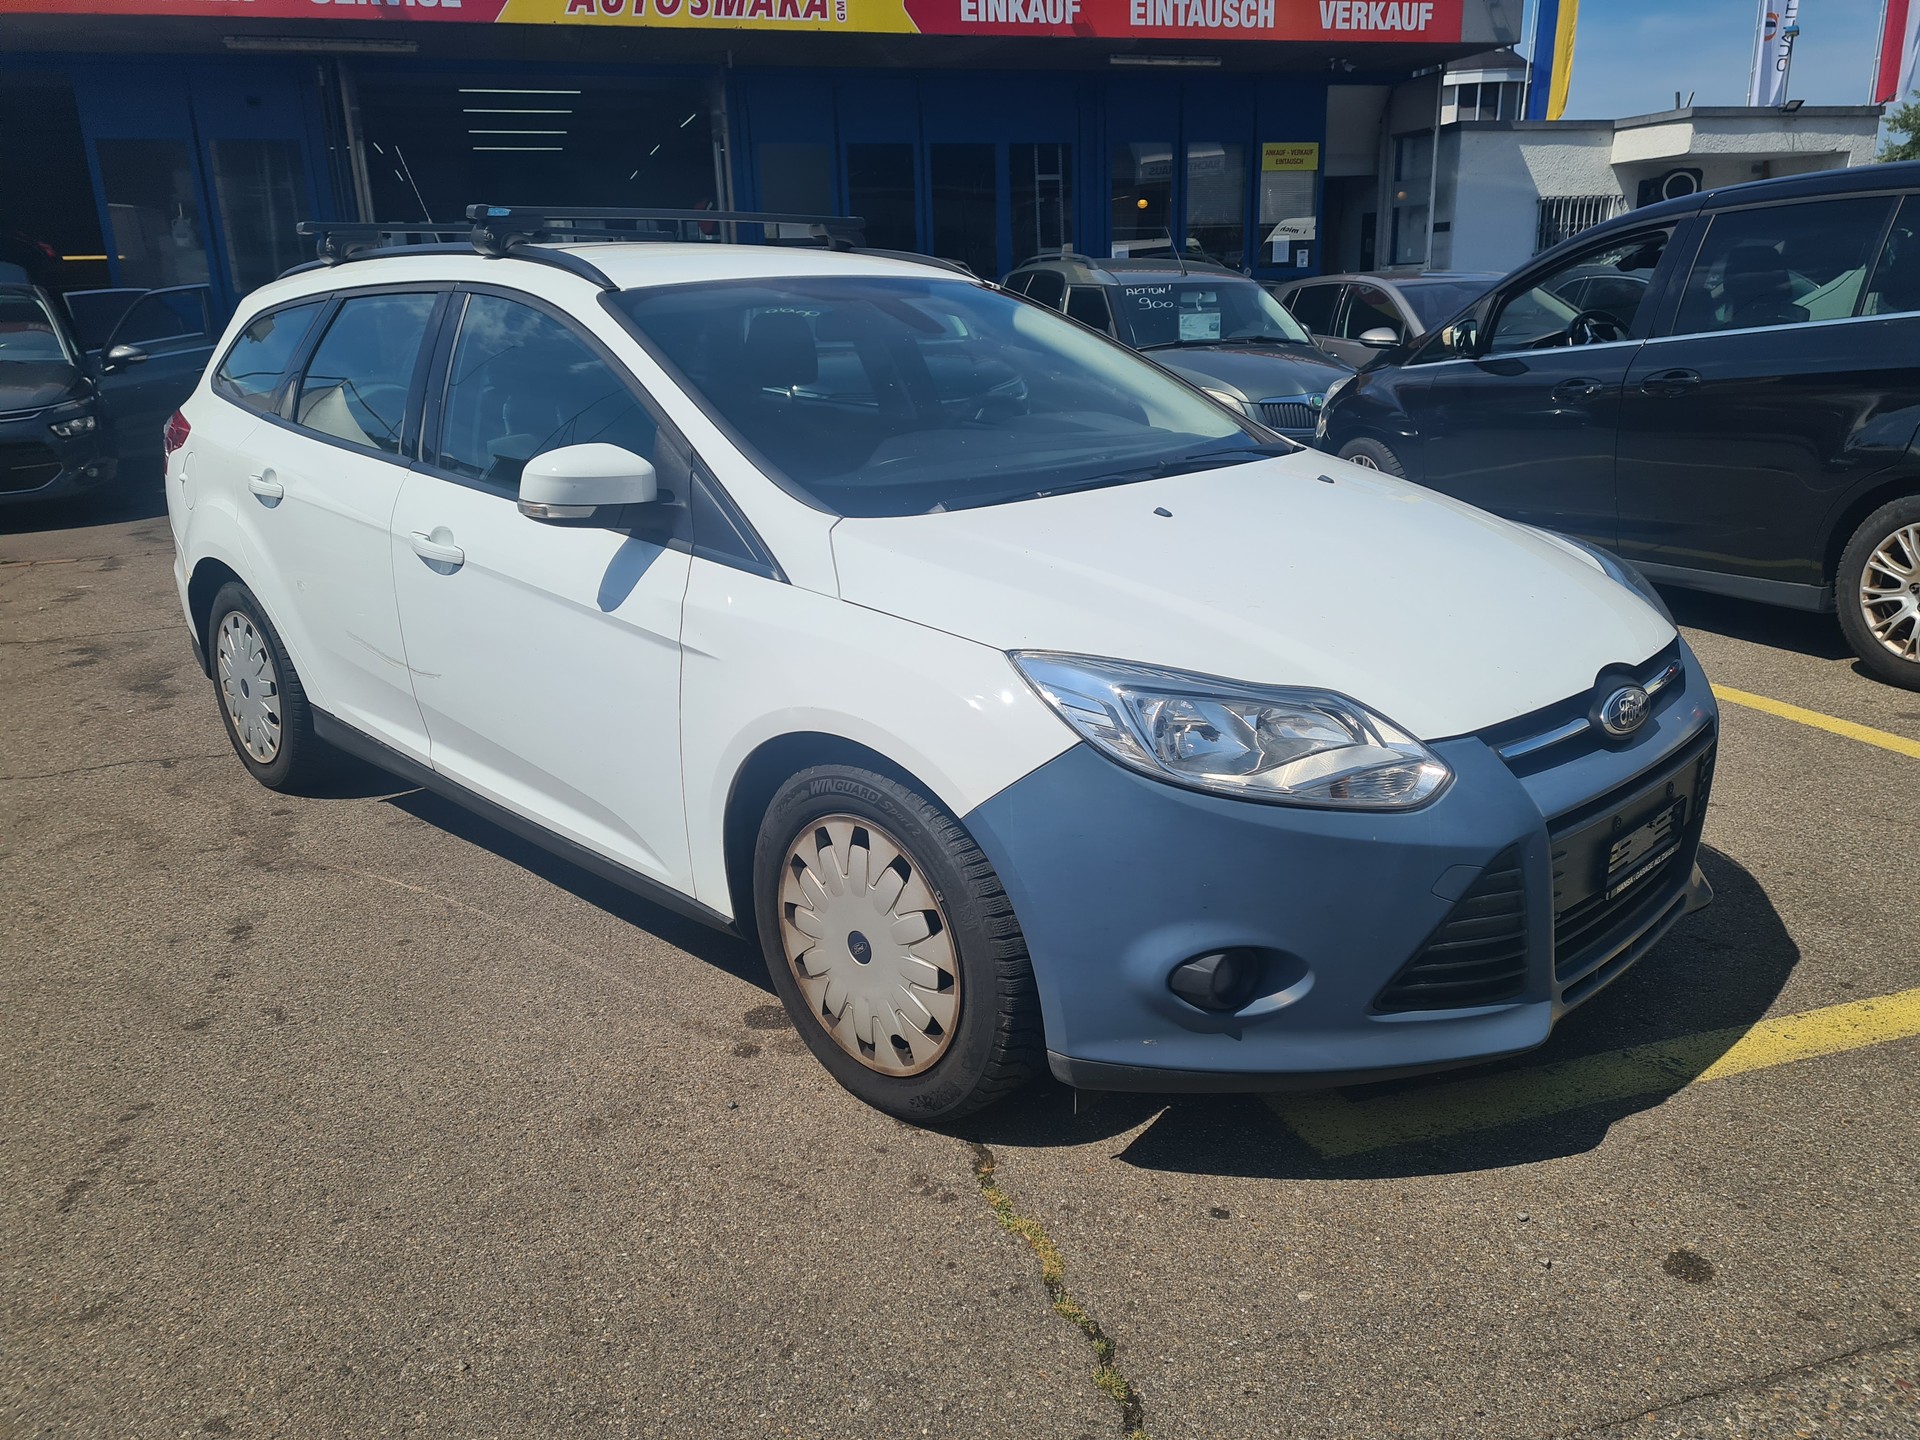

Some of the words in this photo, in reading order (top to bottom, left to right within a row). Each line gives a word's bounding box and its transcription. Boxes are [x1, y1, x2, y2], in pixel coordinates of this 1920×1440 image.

[960, 0, 1080, 24] EINKAUF
[1130, 0, 1274, 28] EINTAUSCH
[1318, 1, 1433, 31] VERKAUF
[1776, 0, 1798, 72] QUALIT
[1290, 148, 1314, 156] VERKAUF
[809, 779, 881, 803] WINGUARD
[878, 801, 914, 828] Sport
[911, 827, 921, 837] 2
